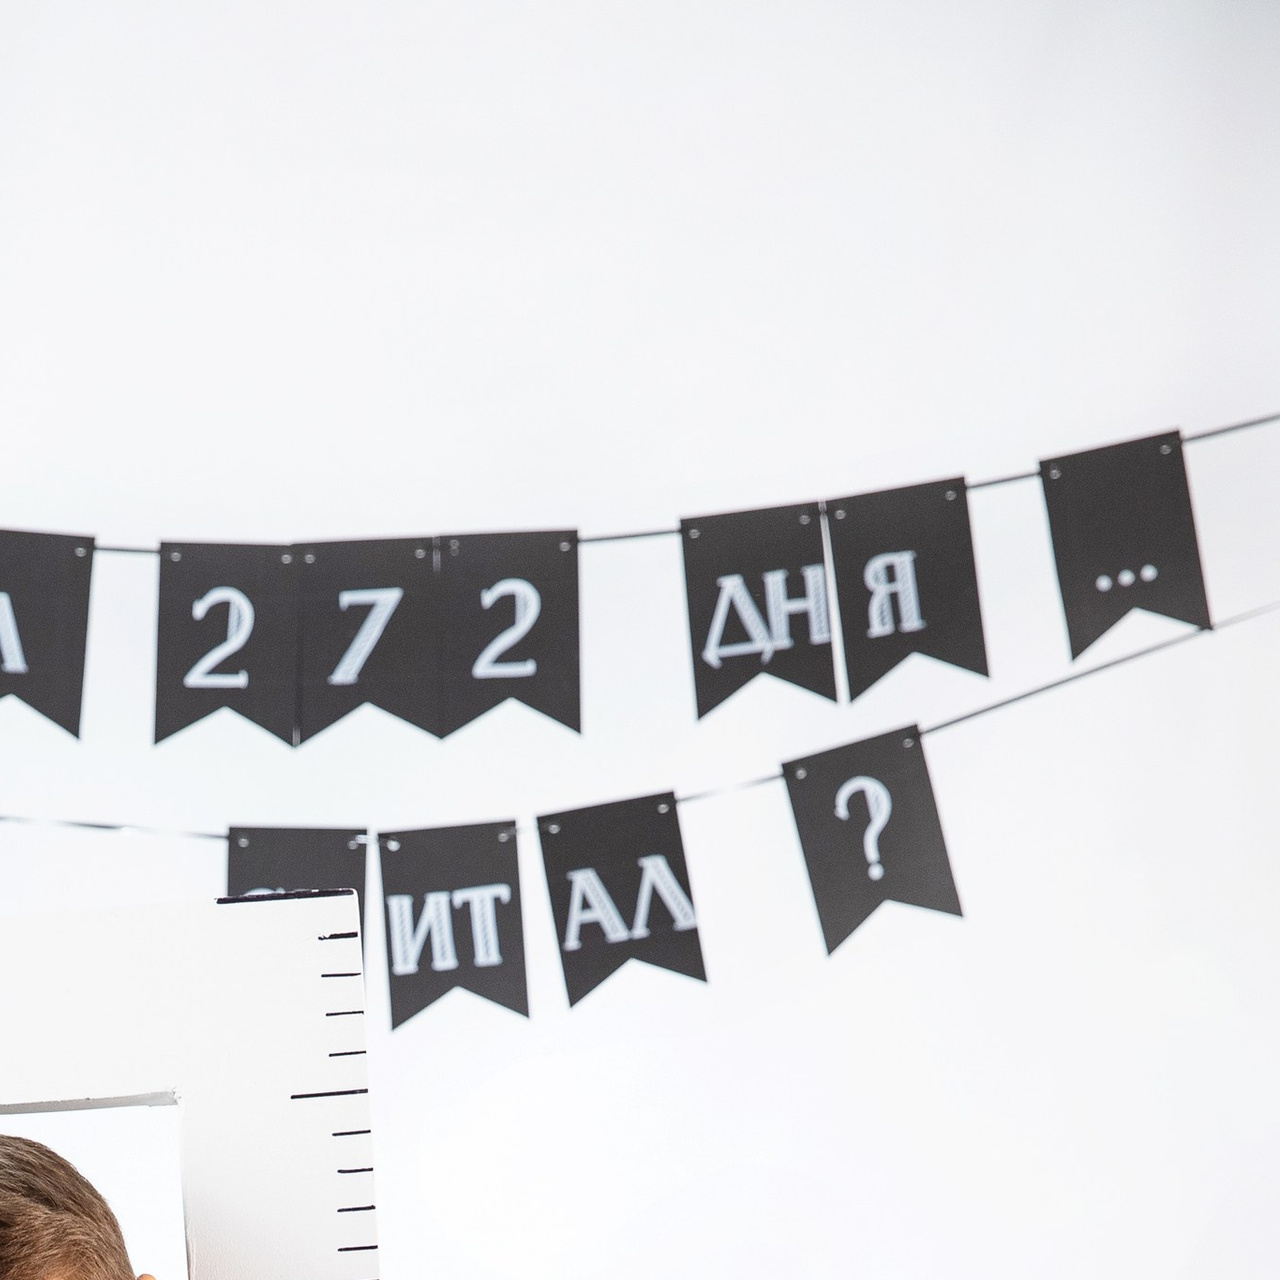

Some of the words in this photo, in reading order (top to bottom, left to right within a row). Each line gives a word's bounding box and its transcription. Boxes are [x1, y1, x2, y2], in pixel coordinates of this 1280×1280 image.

[182, 579, 542, 689] 272
[701, 550, 926, 667] ДНЯ
[242, 854, 698, 976] ИТАЛ
[833, 775, 893, 882] ?
